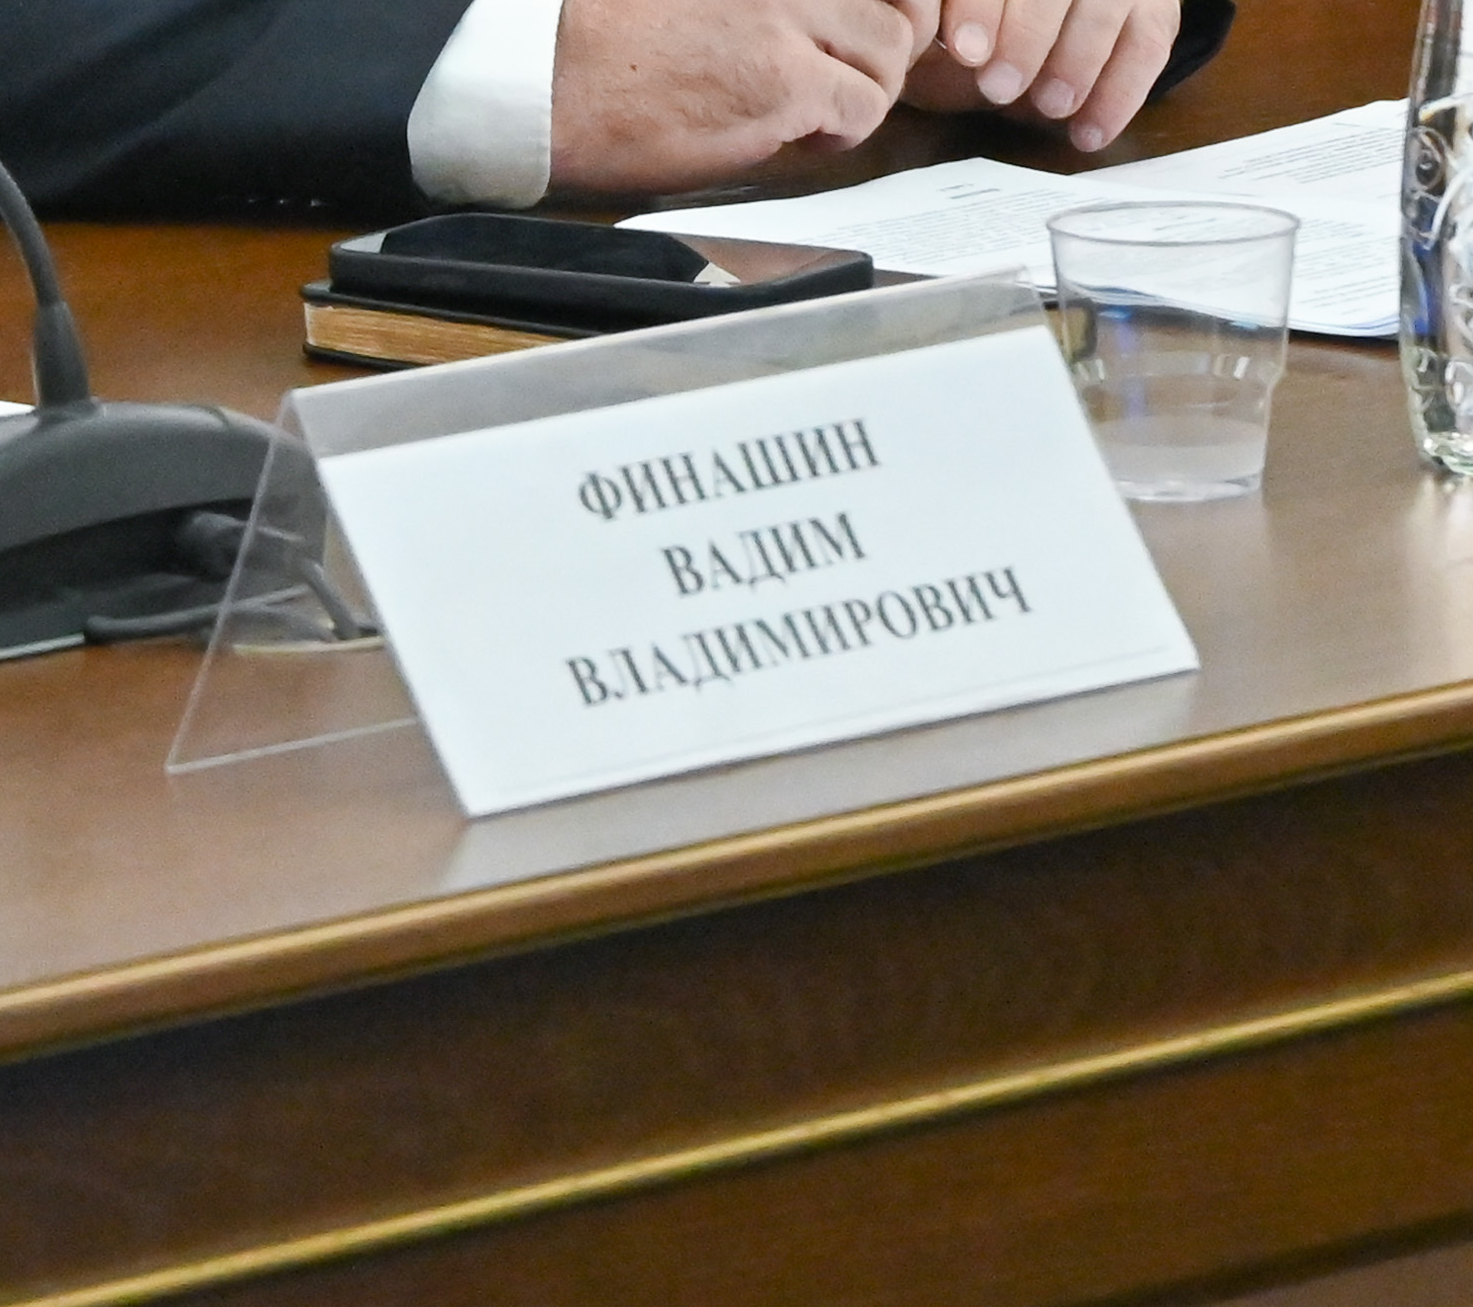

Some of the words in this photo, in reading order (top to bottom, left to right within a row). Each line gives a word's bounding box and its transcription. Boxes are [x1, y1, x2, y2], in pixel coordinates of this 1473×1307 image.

[576, 417, 881, 523] ФИНАШИН
[660, 511, 868, 598] ВАДИМ
[565, 566, 1033, 709] ВЛАДИМИРОВИЧ
